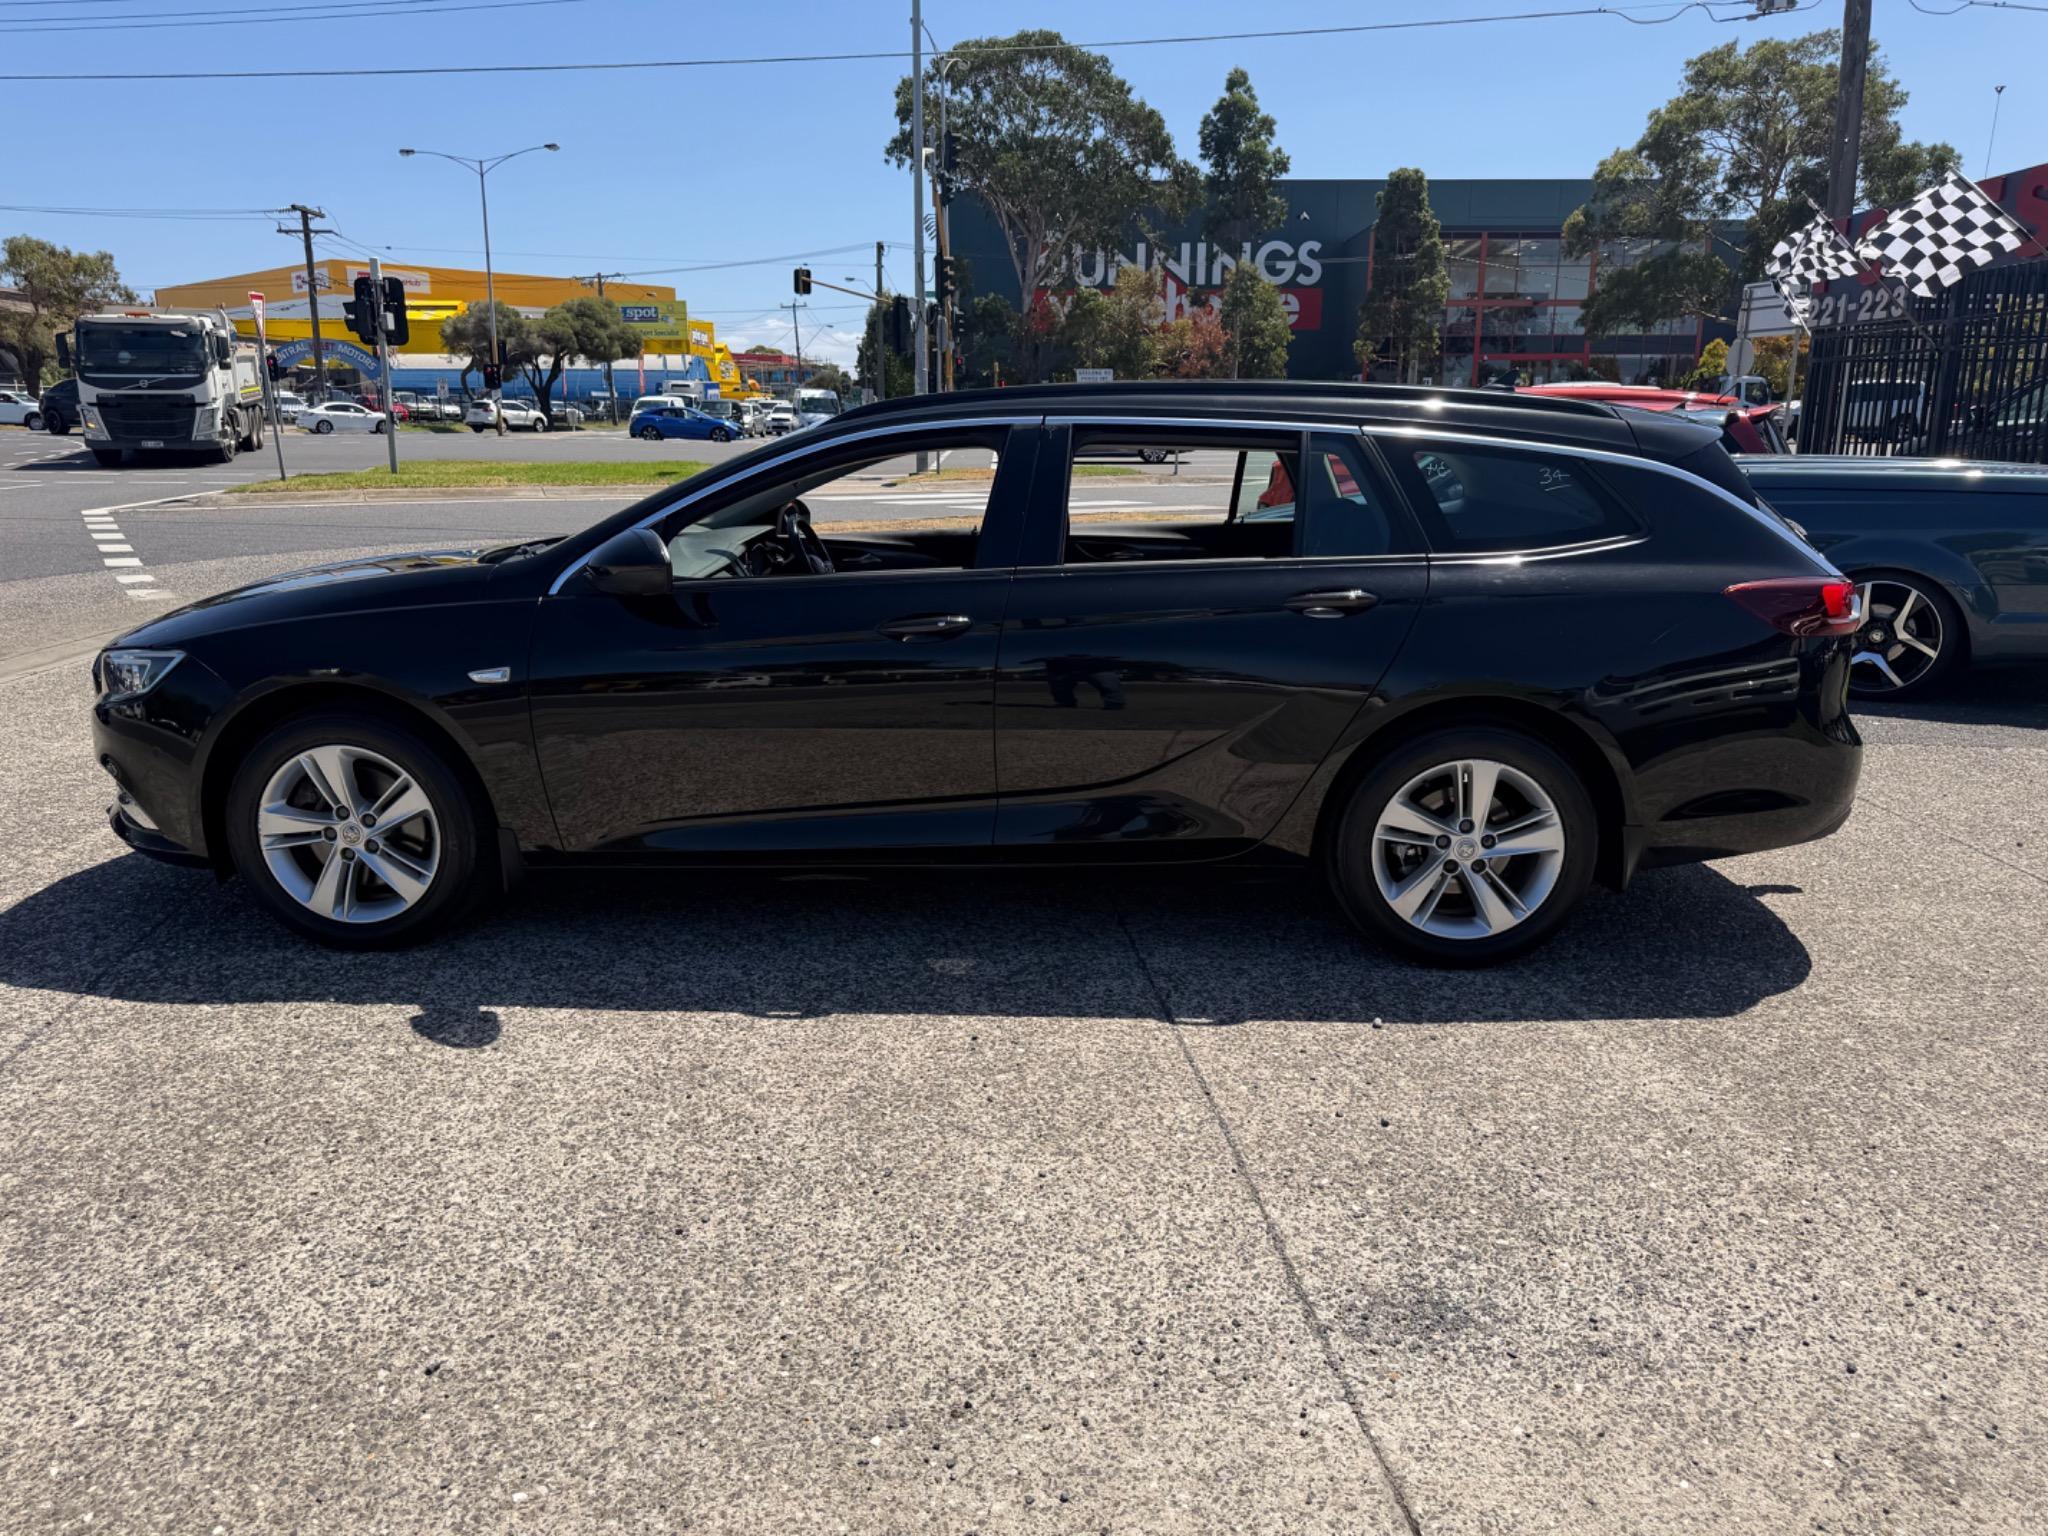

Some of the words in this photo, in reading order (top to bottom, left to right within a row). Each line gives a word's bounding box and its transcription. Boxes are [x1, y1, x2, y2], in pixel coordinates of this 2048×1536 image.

[625, 306, 657, 320] spot
[1807, 285, 1906, 327] 221-223
[337, 344, 377, 370] MOTORS
